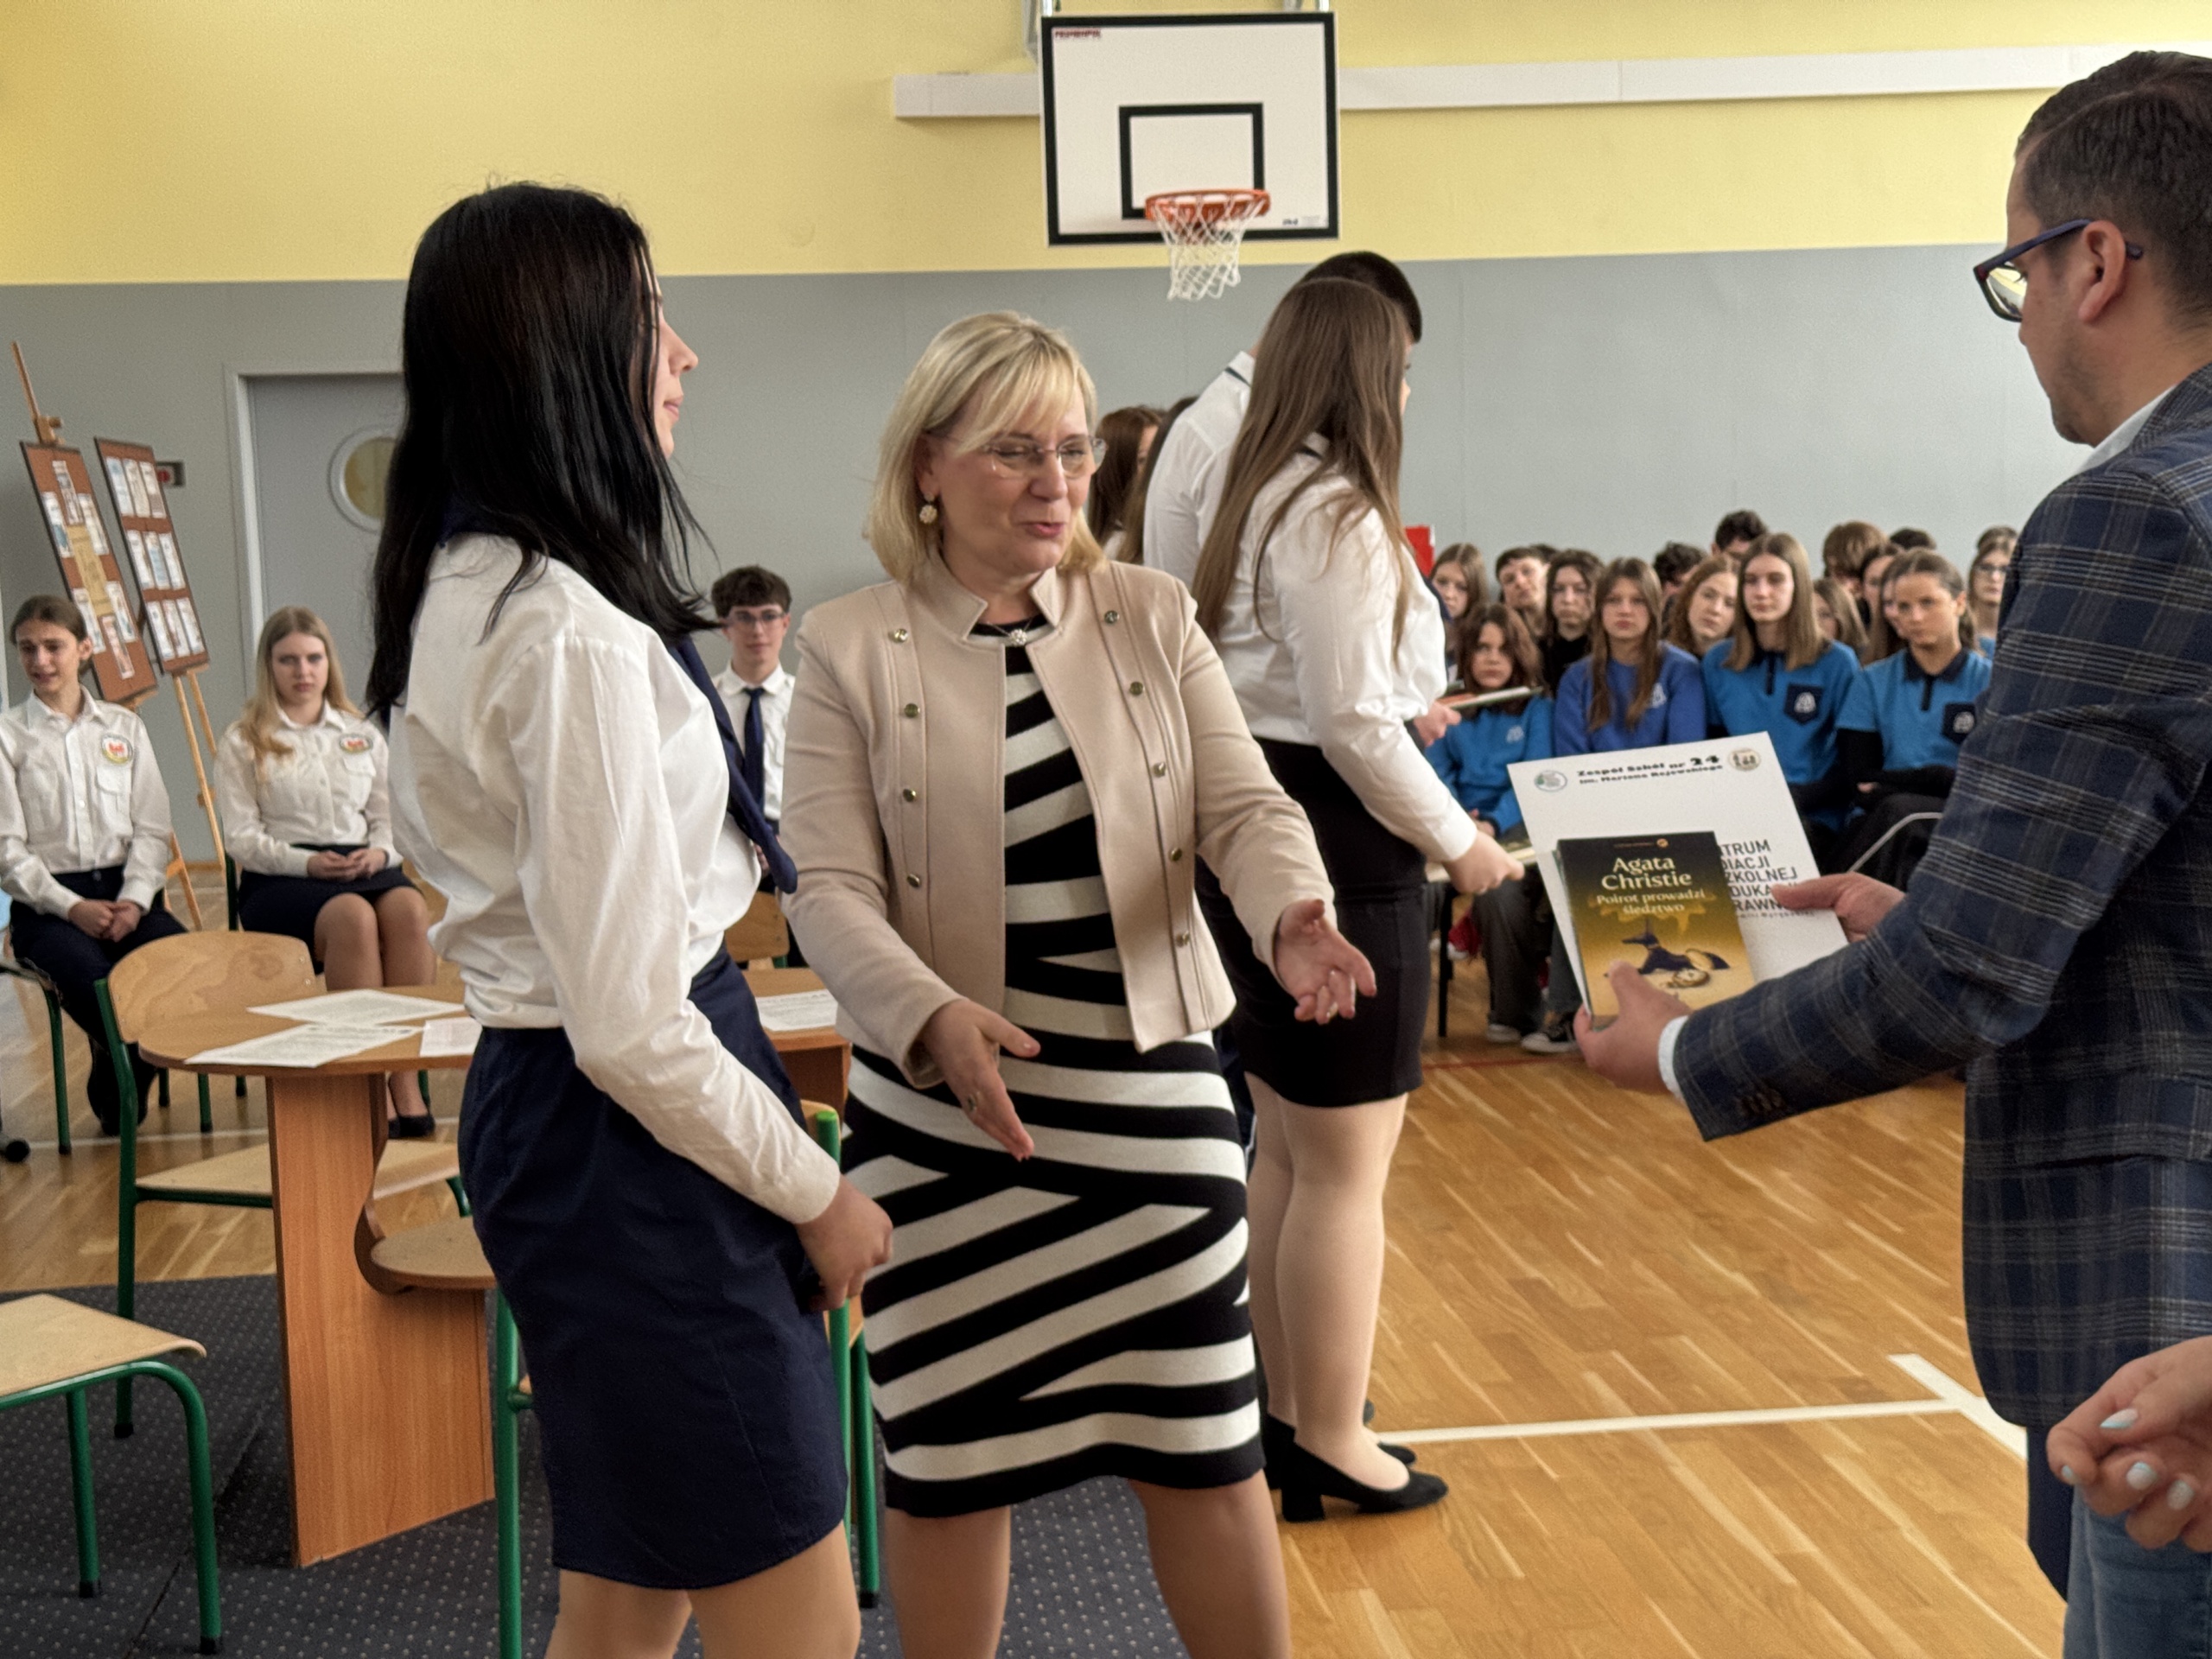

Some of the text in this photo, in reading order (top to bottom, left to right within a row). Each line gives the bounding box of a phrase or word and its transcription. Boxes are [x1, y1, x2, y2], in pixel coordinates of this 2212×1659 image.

[1689, 754, 1719, 766] 24
[1612, 857, 1675, 875] Agata
[1601, 871, 1693, 891] Christie
[1597, 888, 1706, 905] Poirot prowadzi
